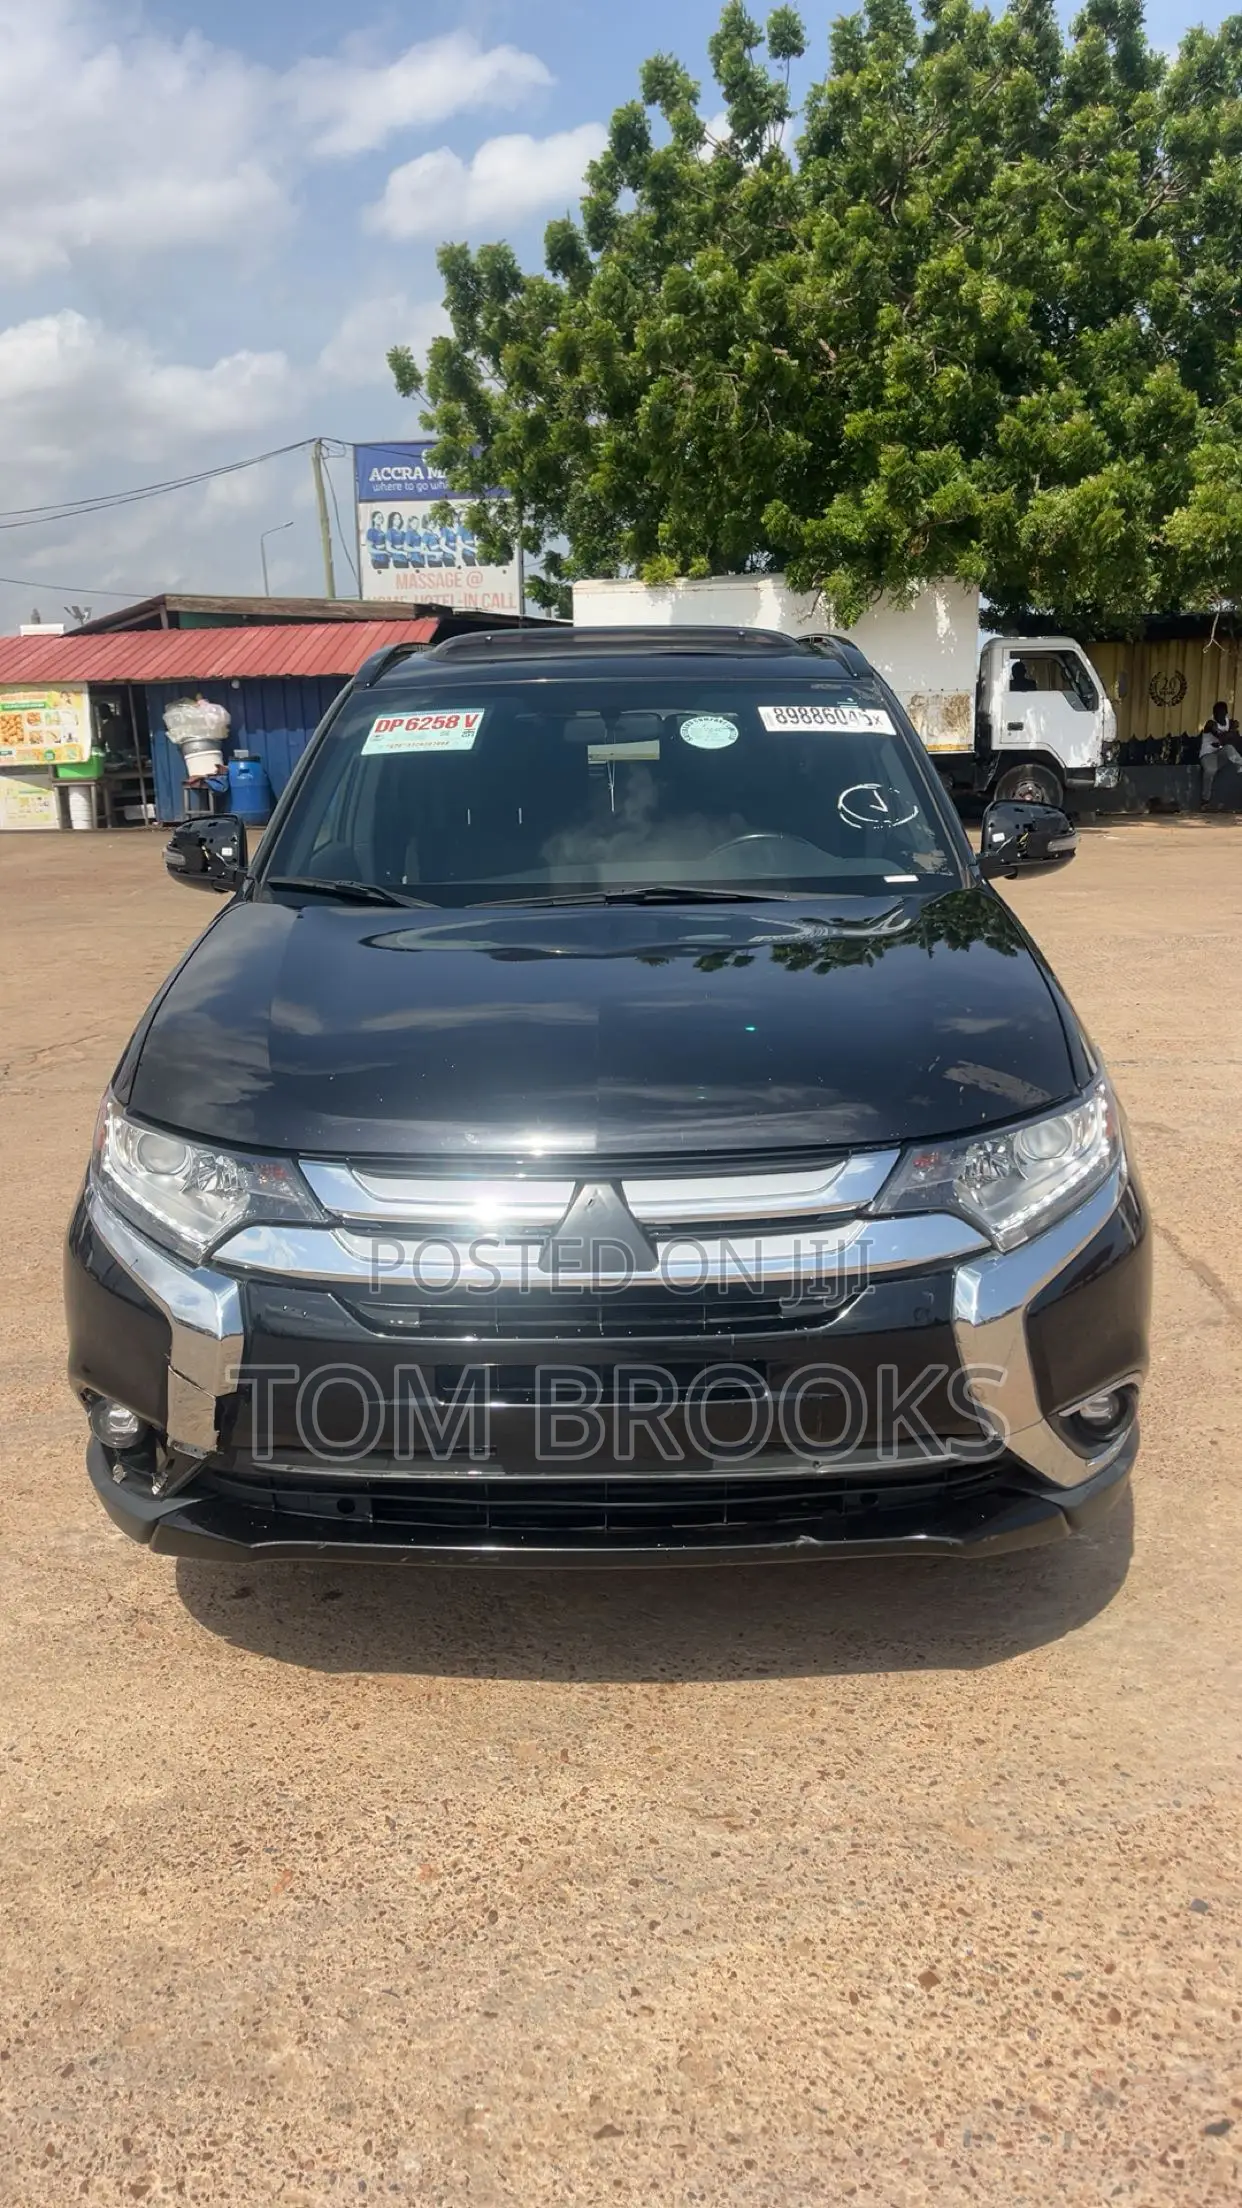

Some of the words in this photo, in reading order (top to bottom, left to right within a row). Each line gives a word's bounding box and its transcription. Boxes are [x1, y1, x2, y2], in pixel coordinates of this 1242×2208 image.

[369, 467, 425, 481] ACCRA
[373, 482, 402, 492] where
[404, 482, 415, 491] to
[416, 483, 428, 492] go
[396, 572, 461, 589] MASSAGE
[466, 571, 483, 588] @
[482, 593, 516, 609] CALL
[374, 719, 404, 733] DP
[405, 715, 460, 731] 6258
[464, 714, 479, 728] V
